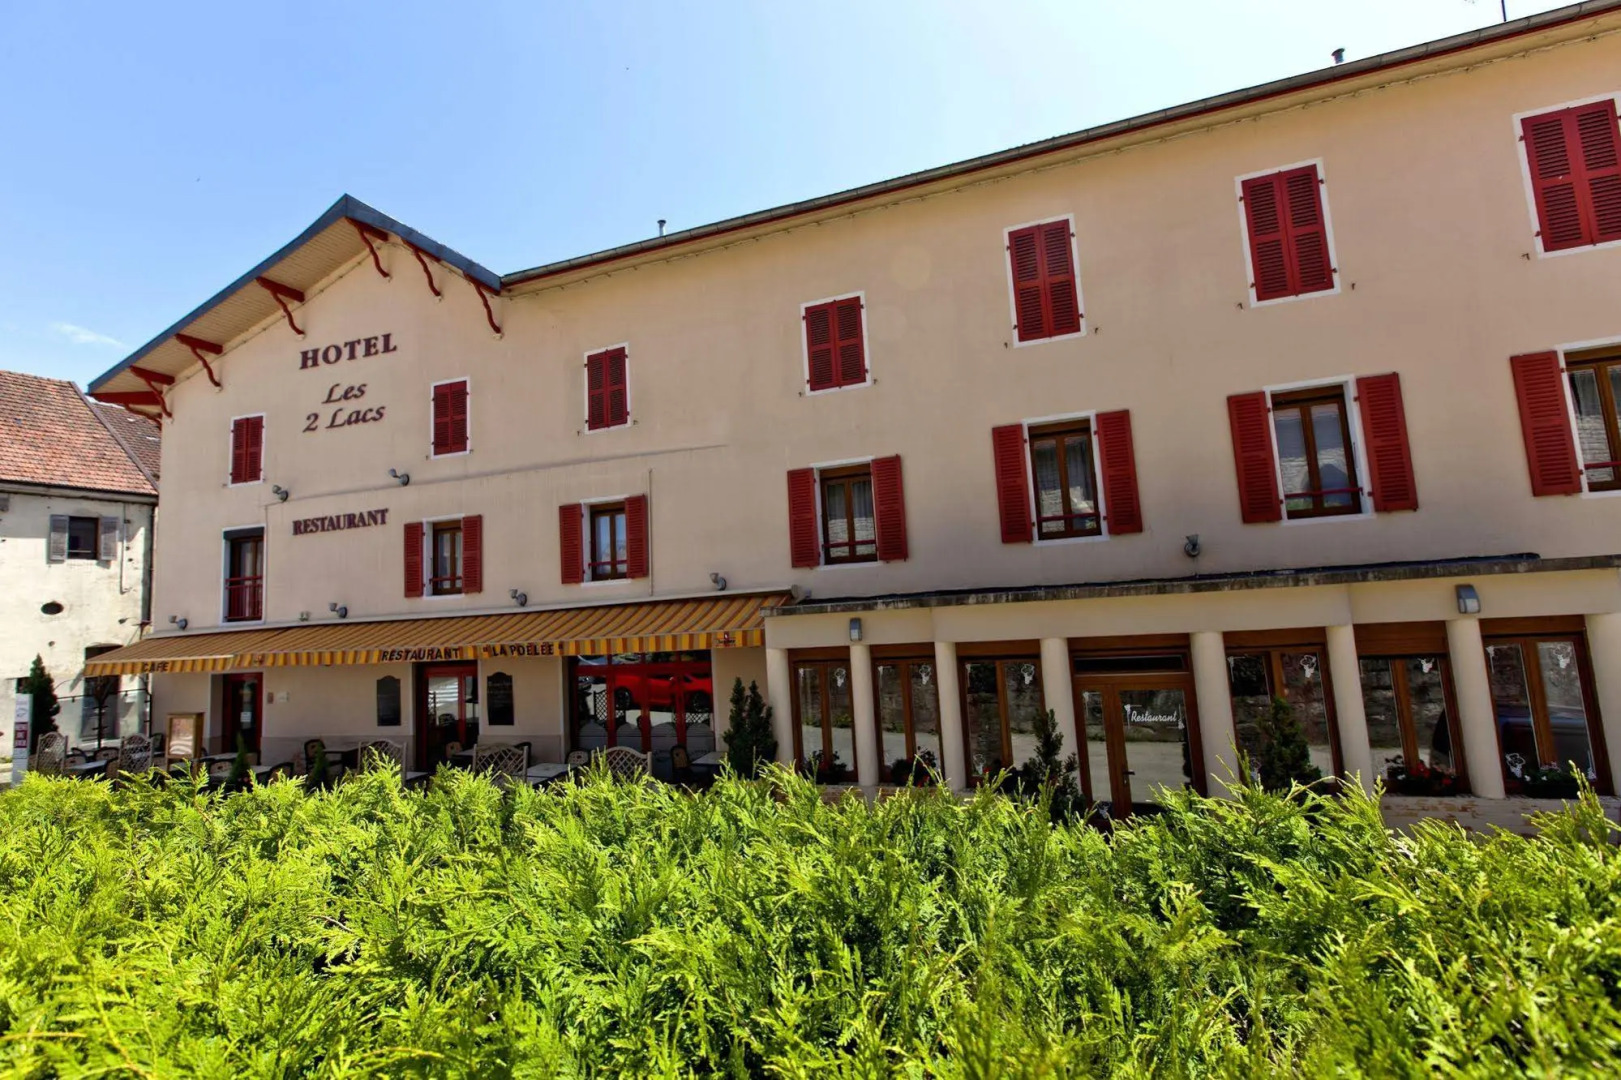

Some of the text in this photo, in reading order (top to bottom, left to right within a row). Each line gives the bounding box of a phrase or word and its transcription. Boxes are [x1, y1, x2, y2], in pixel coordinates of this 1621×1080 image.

[299, 333, 397, 370] HOTEL
[321, 383, 367, 404] Les
[302, 406, 386, 433] 2 Lacs
[292, 508, 389, 535] RESTAURANT
[381, 648, 460, 661] RESTAURANT
[1130, 710, 1177, 723] Restaurant
